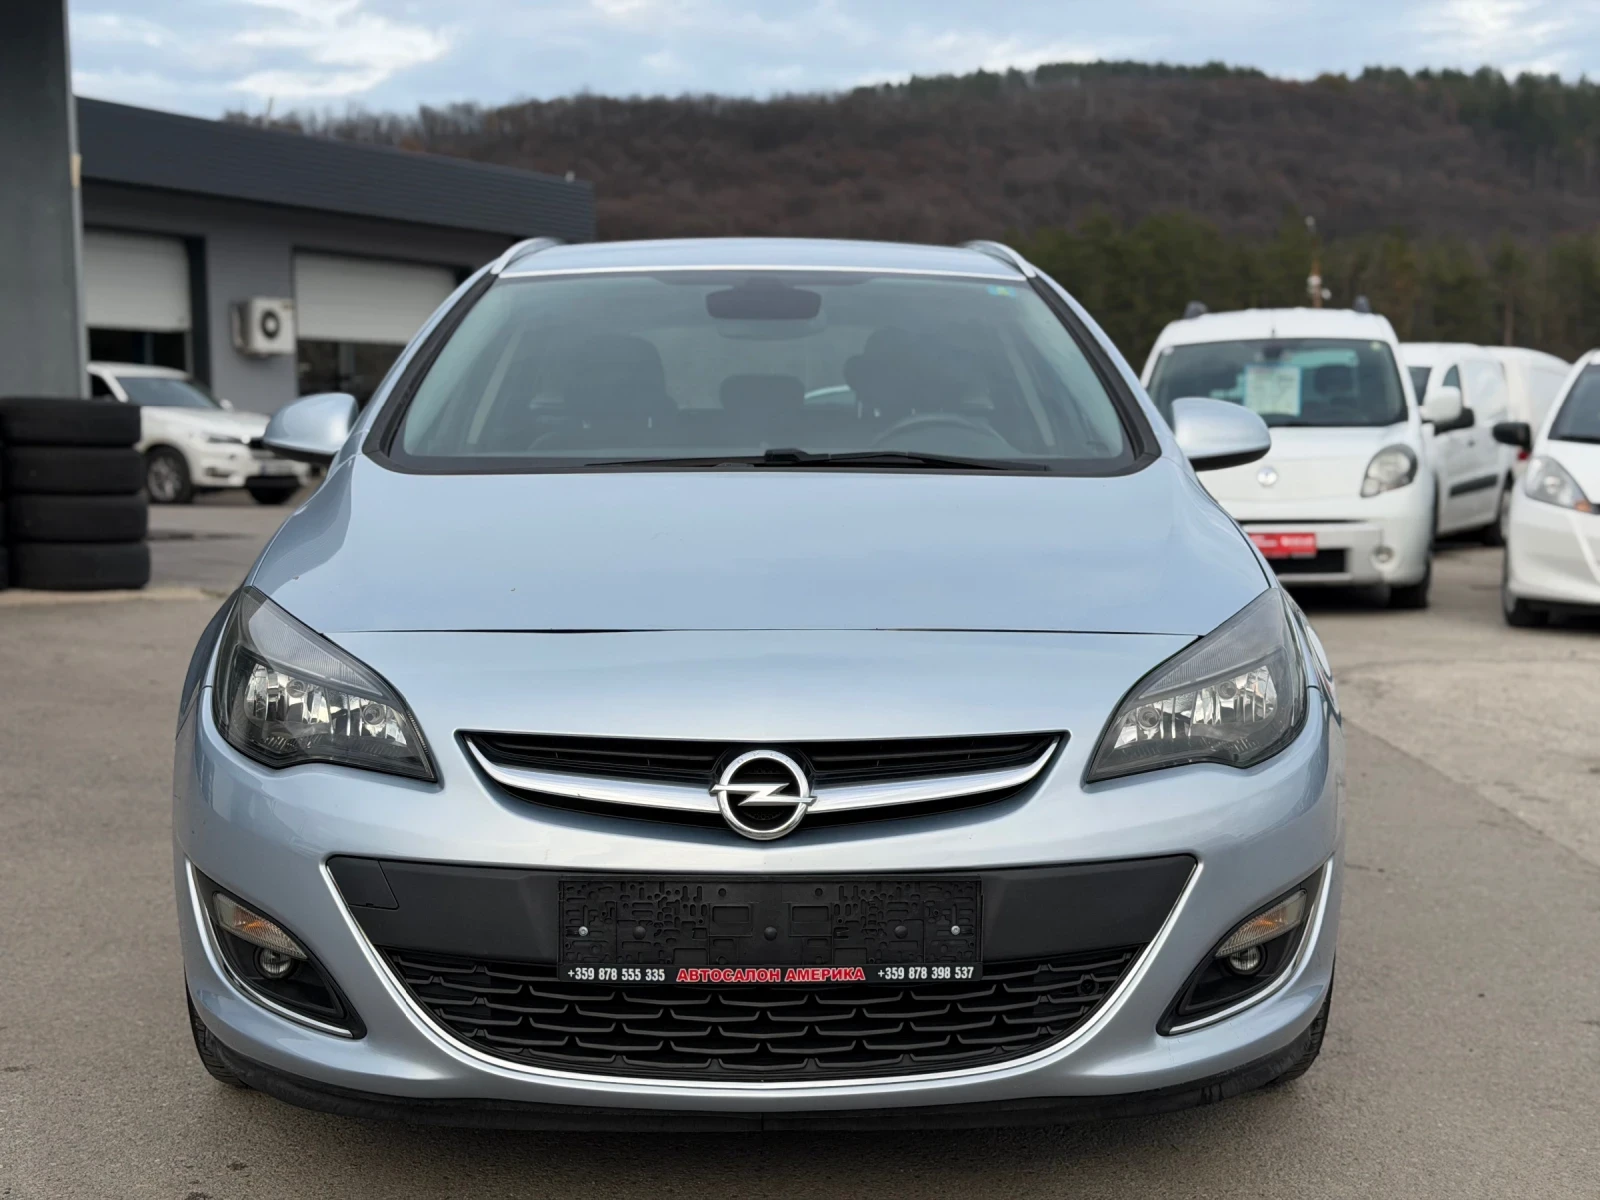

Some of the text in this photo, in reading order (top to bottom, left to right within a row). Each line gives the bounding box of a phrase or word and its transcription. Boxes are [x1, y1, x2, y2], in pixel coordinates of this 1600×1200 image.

[567, 966, 975, 983] +359 878 555 335 АВТОСАЛОН АМЕРИКА +359 878 398 537
